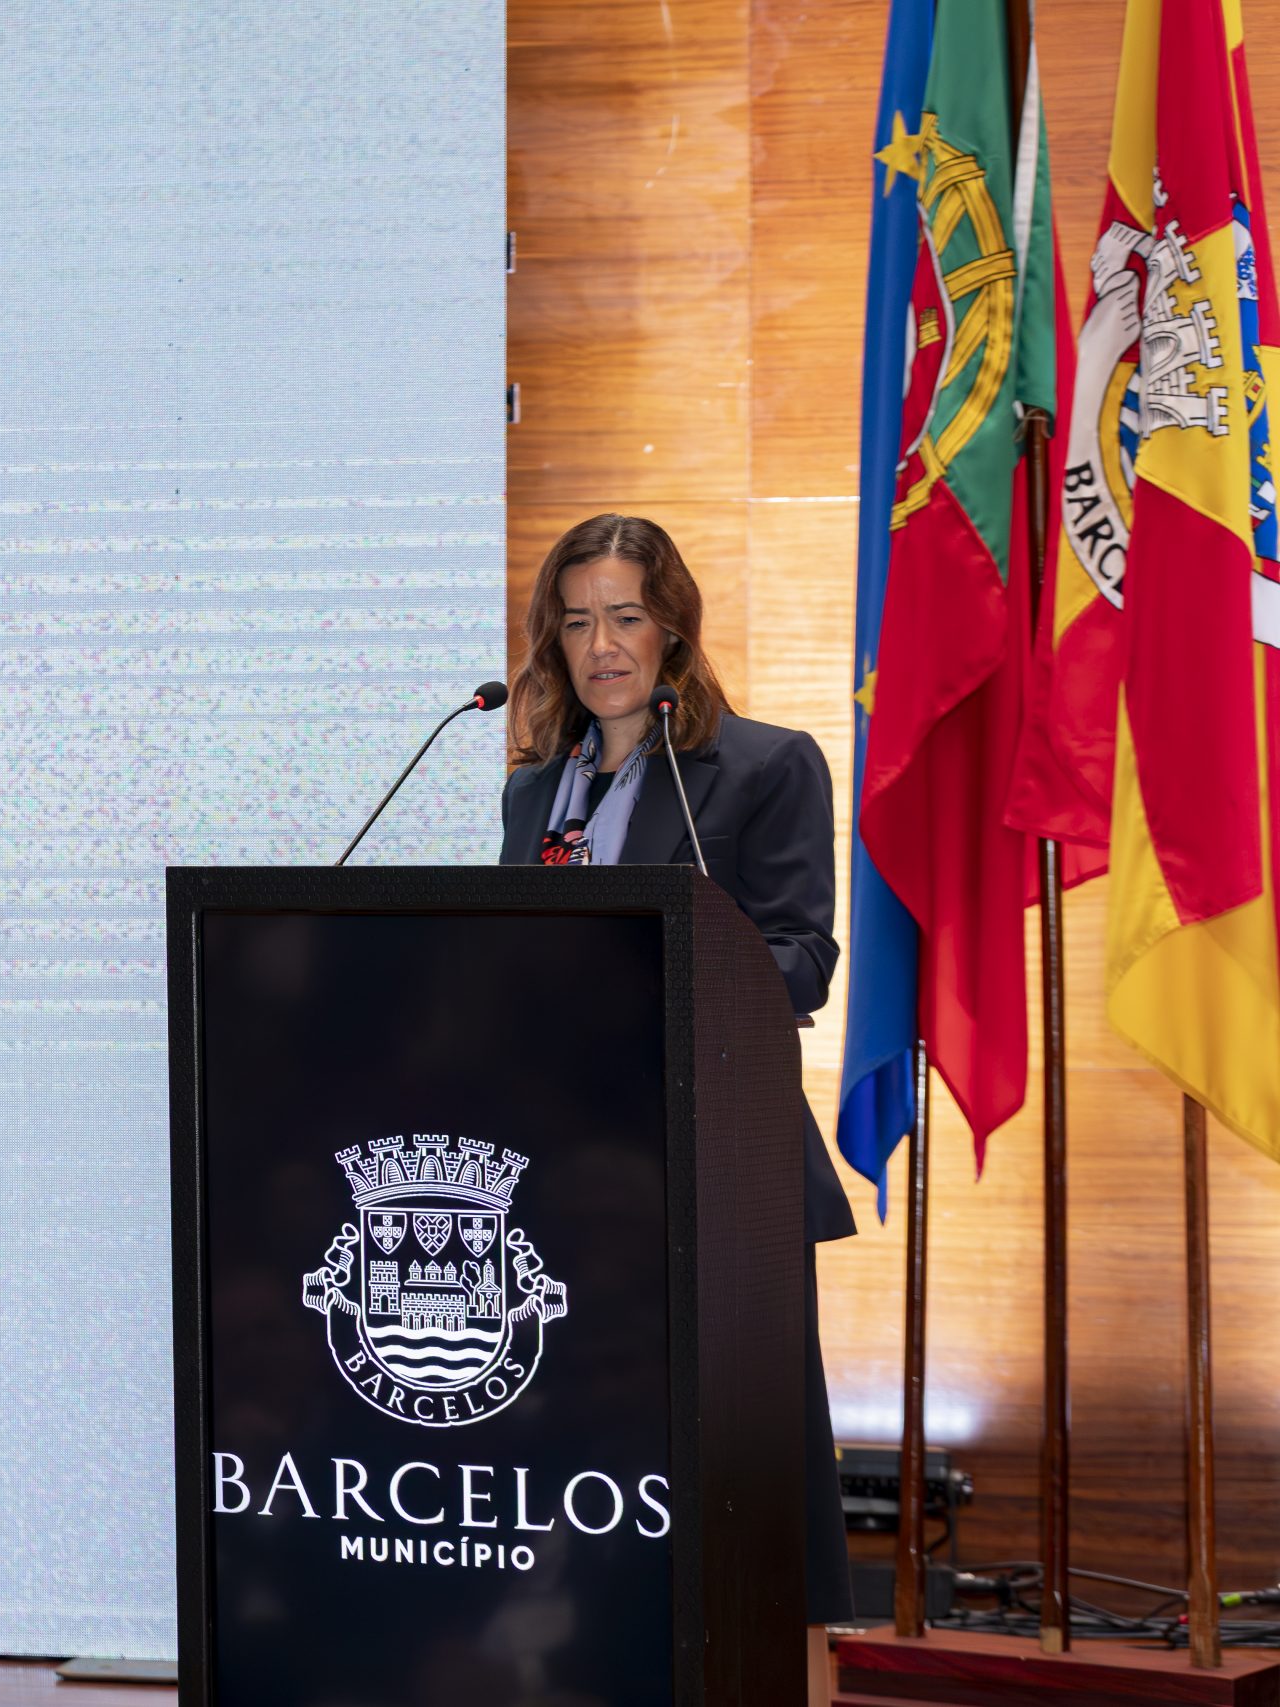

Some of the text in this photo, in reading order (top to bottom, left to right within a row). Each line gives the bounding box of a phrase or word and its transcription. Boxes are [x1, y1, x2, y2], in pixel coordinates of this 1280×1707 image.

[1064, 460, 1127, 595] BARC
[345, 1350, 525, 1420] BARCELOS
[213, 1451, 671, 1539] BARCELOS
[341, 1536, 535, 1570] MUNICÍPIO
